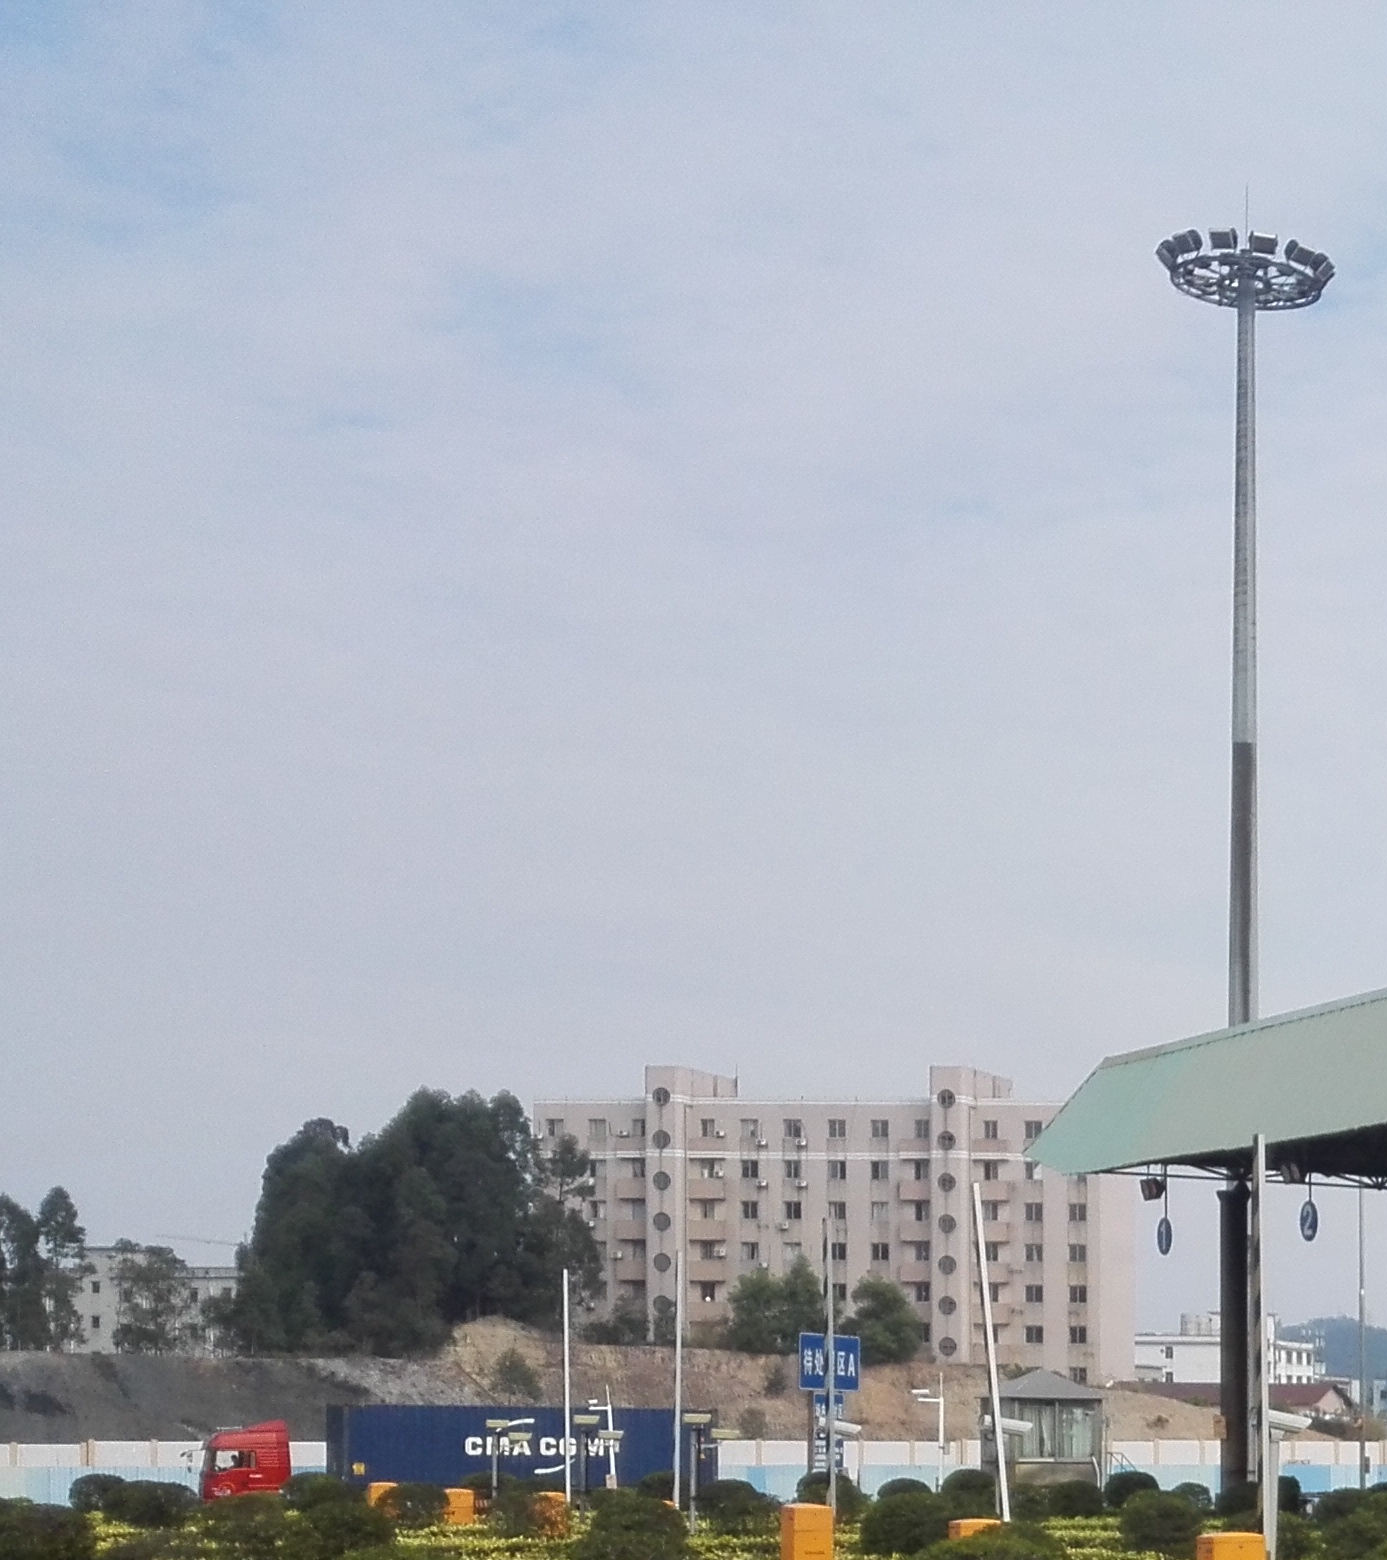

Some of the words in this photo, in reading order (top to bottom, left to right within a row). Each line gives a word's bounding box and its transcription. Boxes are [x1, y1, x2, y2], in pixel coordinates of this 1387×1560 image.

[1302, 1204, 1314, 1236] 2
[1159, 1222, 1167, 1251] 1
[464, 1436, 532, 1456] CMA
